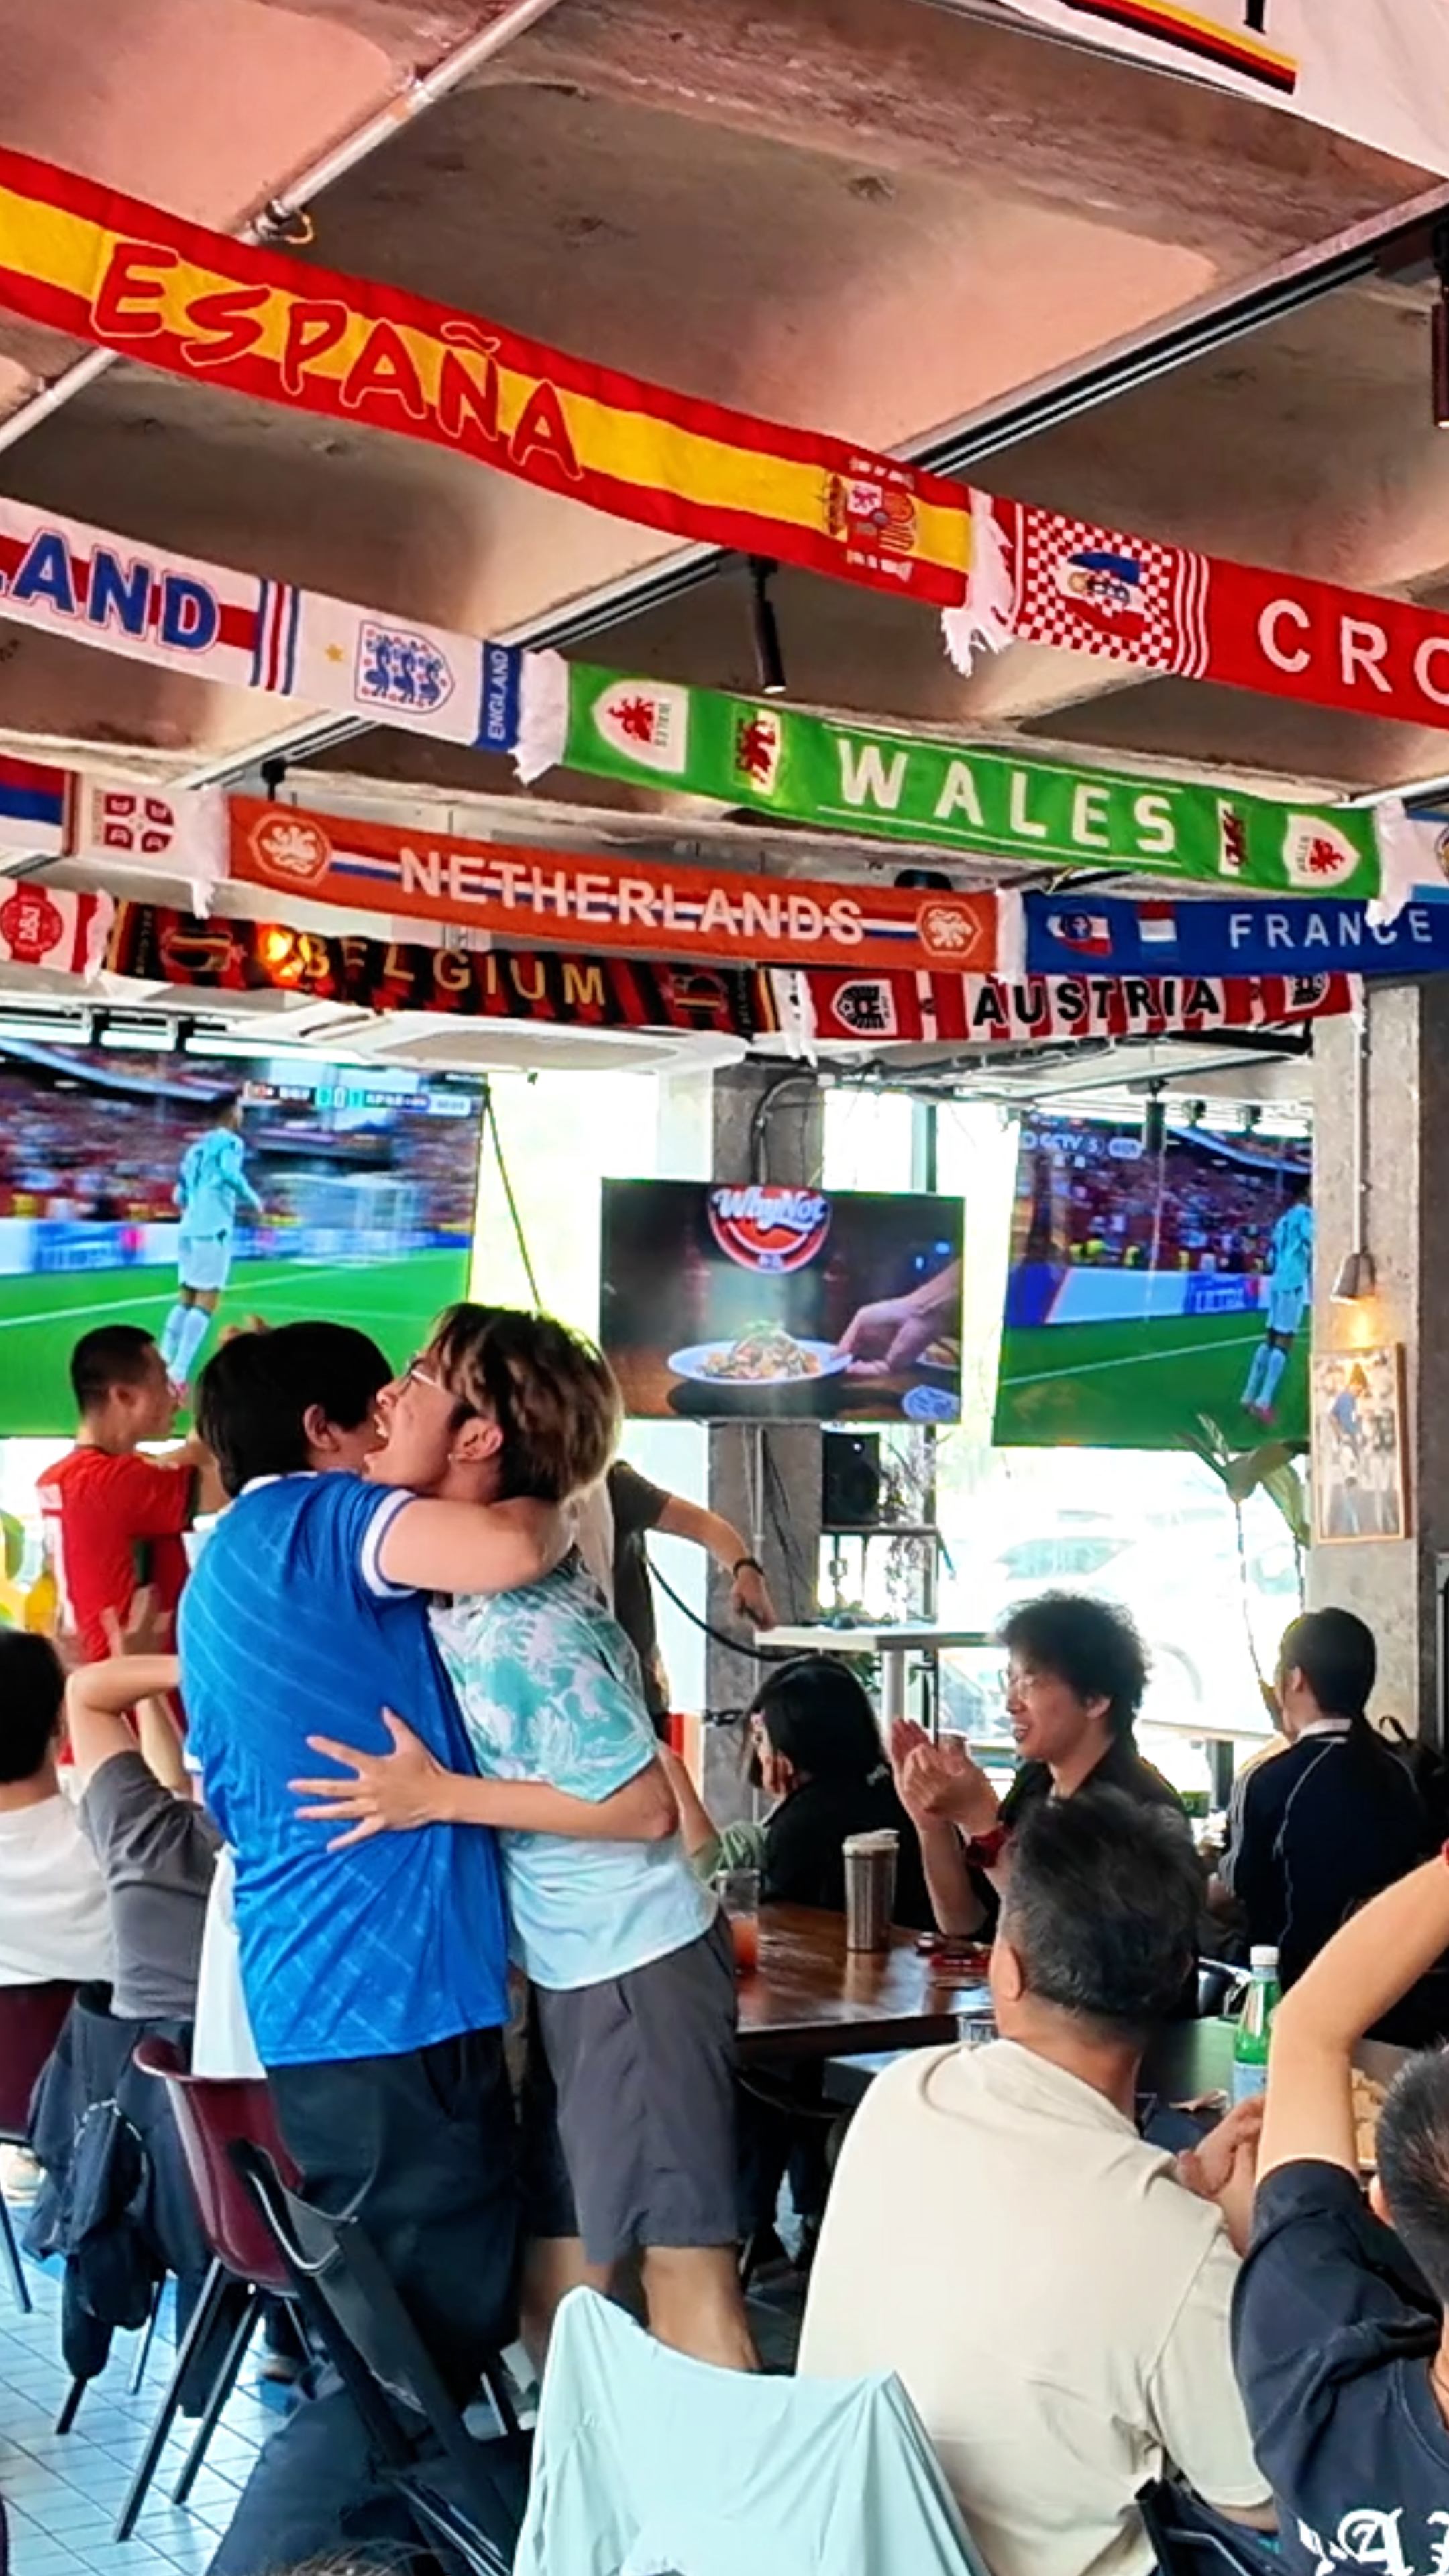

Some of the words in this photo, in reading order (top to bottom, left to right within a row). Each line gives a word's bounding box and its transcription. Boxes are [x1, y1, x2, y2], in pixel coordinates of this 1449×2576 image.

[91, 239, 583, 480] ESPAÑA
[0, 529, 218, 651] AND
[487, 649, 508, 742] ENGLAND
[837, 738, 1176, 853] WALES
[400, 848, 864, 945] NETHERLANDS
[299, 933, 606, 1006] BELGIUM
[973, 978, 1220, 1026] AUSTRIA
